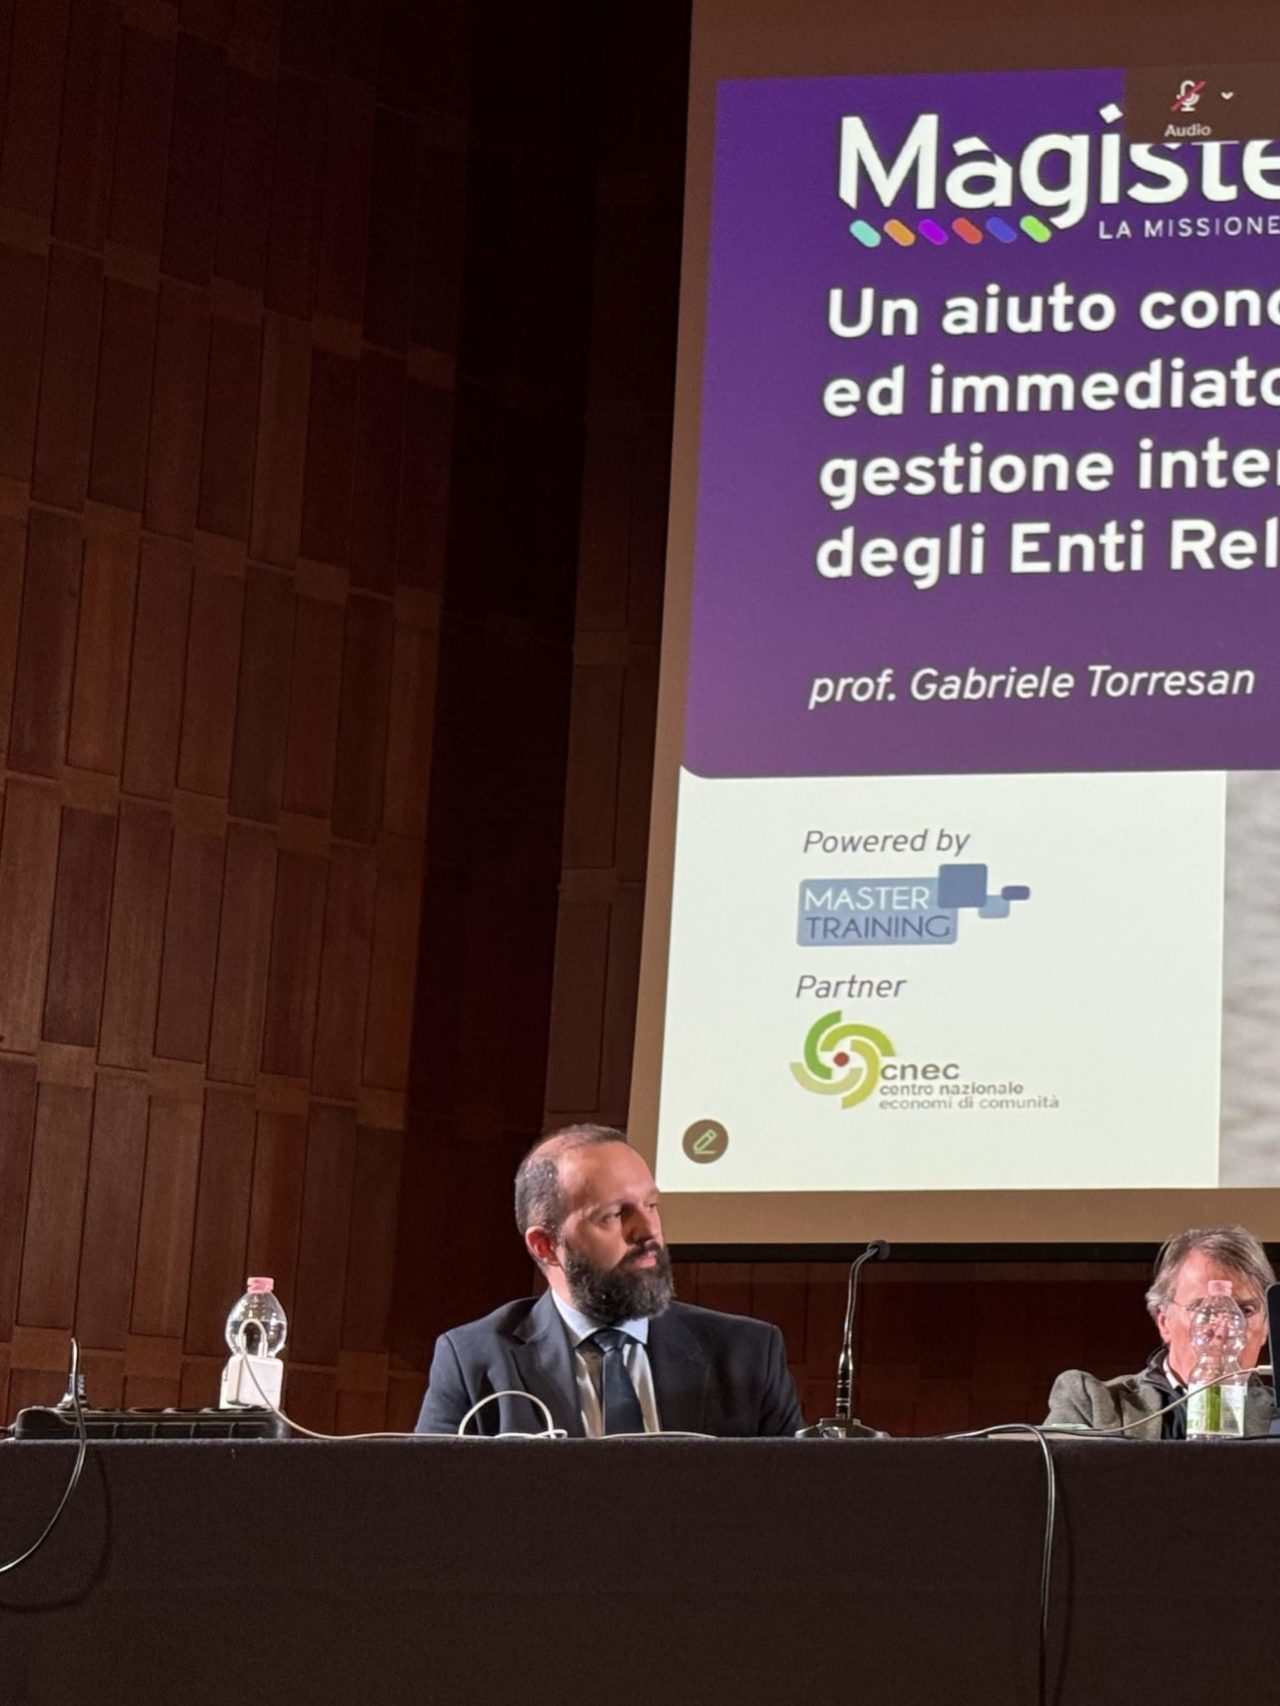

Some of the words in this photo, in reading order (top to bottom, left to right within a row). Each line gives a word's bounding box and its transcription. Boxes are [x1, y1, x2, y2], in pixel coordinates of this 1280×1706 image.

[1164, 123, 1212, 137] Audio
[1099, 220, 1132, 240] LA
[828, 287, 918, 338] Un
[942, 282, 1116, 335] aiuto
[823, 364, 905, 417] ed
[820, 442, 1114, 511] gestione
[816, 522, 986, 590] degli
[1010, 519, 1145, 573] Enti
[808, 668, 896, 710] prof.
[910, 665, 1075, 701] Gabriele
[1088, 664, 1255, 697] Torresan
[803, 828, 929, 854] Powered
[935, 828, 971, 857] by
[804, 886, 930, 911] MASTER
[805, 914, 951, 939] TRAINING
[795, 974, 908, 999] Partner
[879, 1063, 960, 1081] cnec
[879, 1083, 934, 1096] centro
[939, 1081, 1025, 1096] nazionale
[878, 1096, 953, 1111] economi
[957, 1095, 974, 1109] di
[977, 1092, 1060, 1110] comunità
